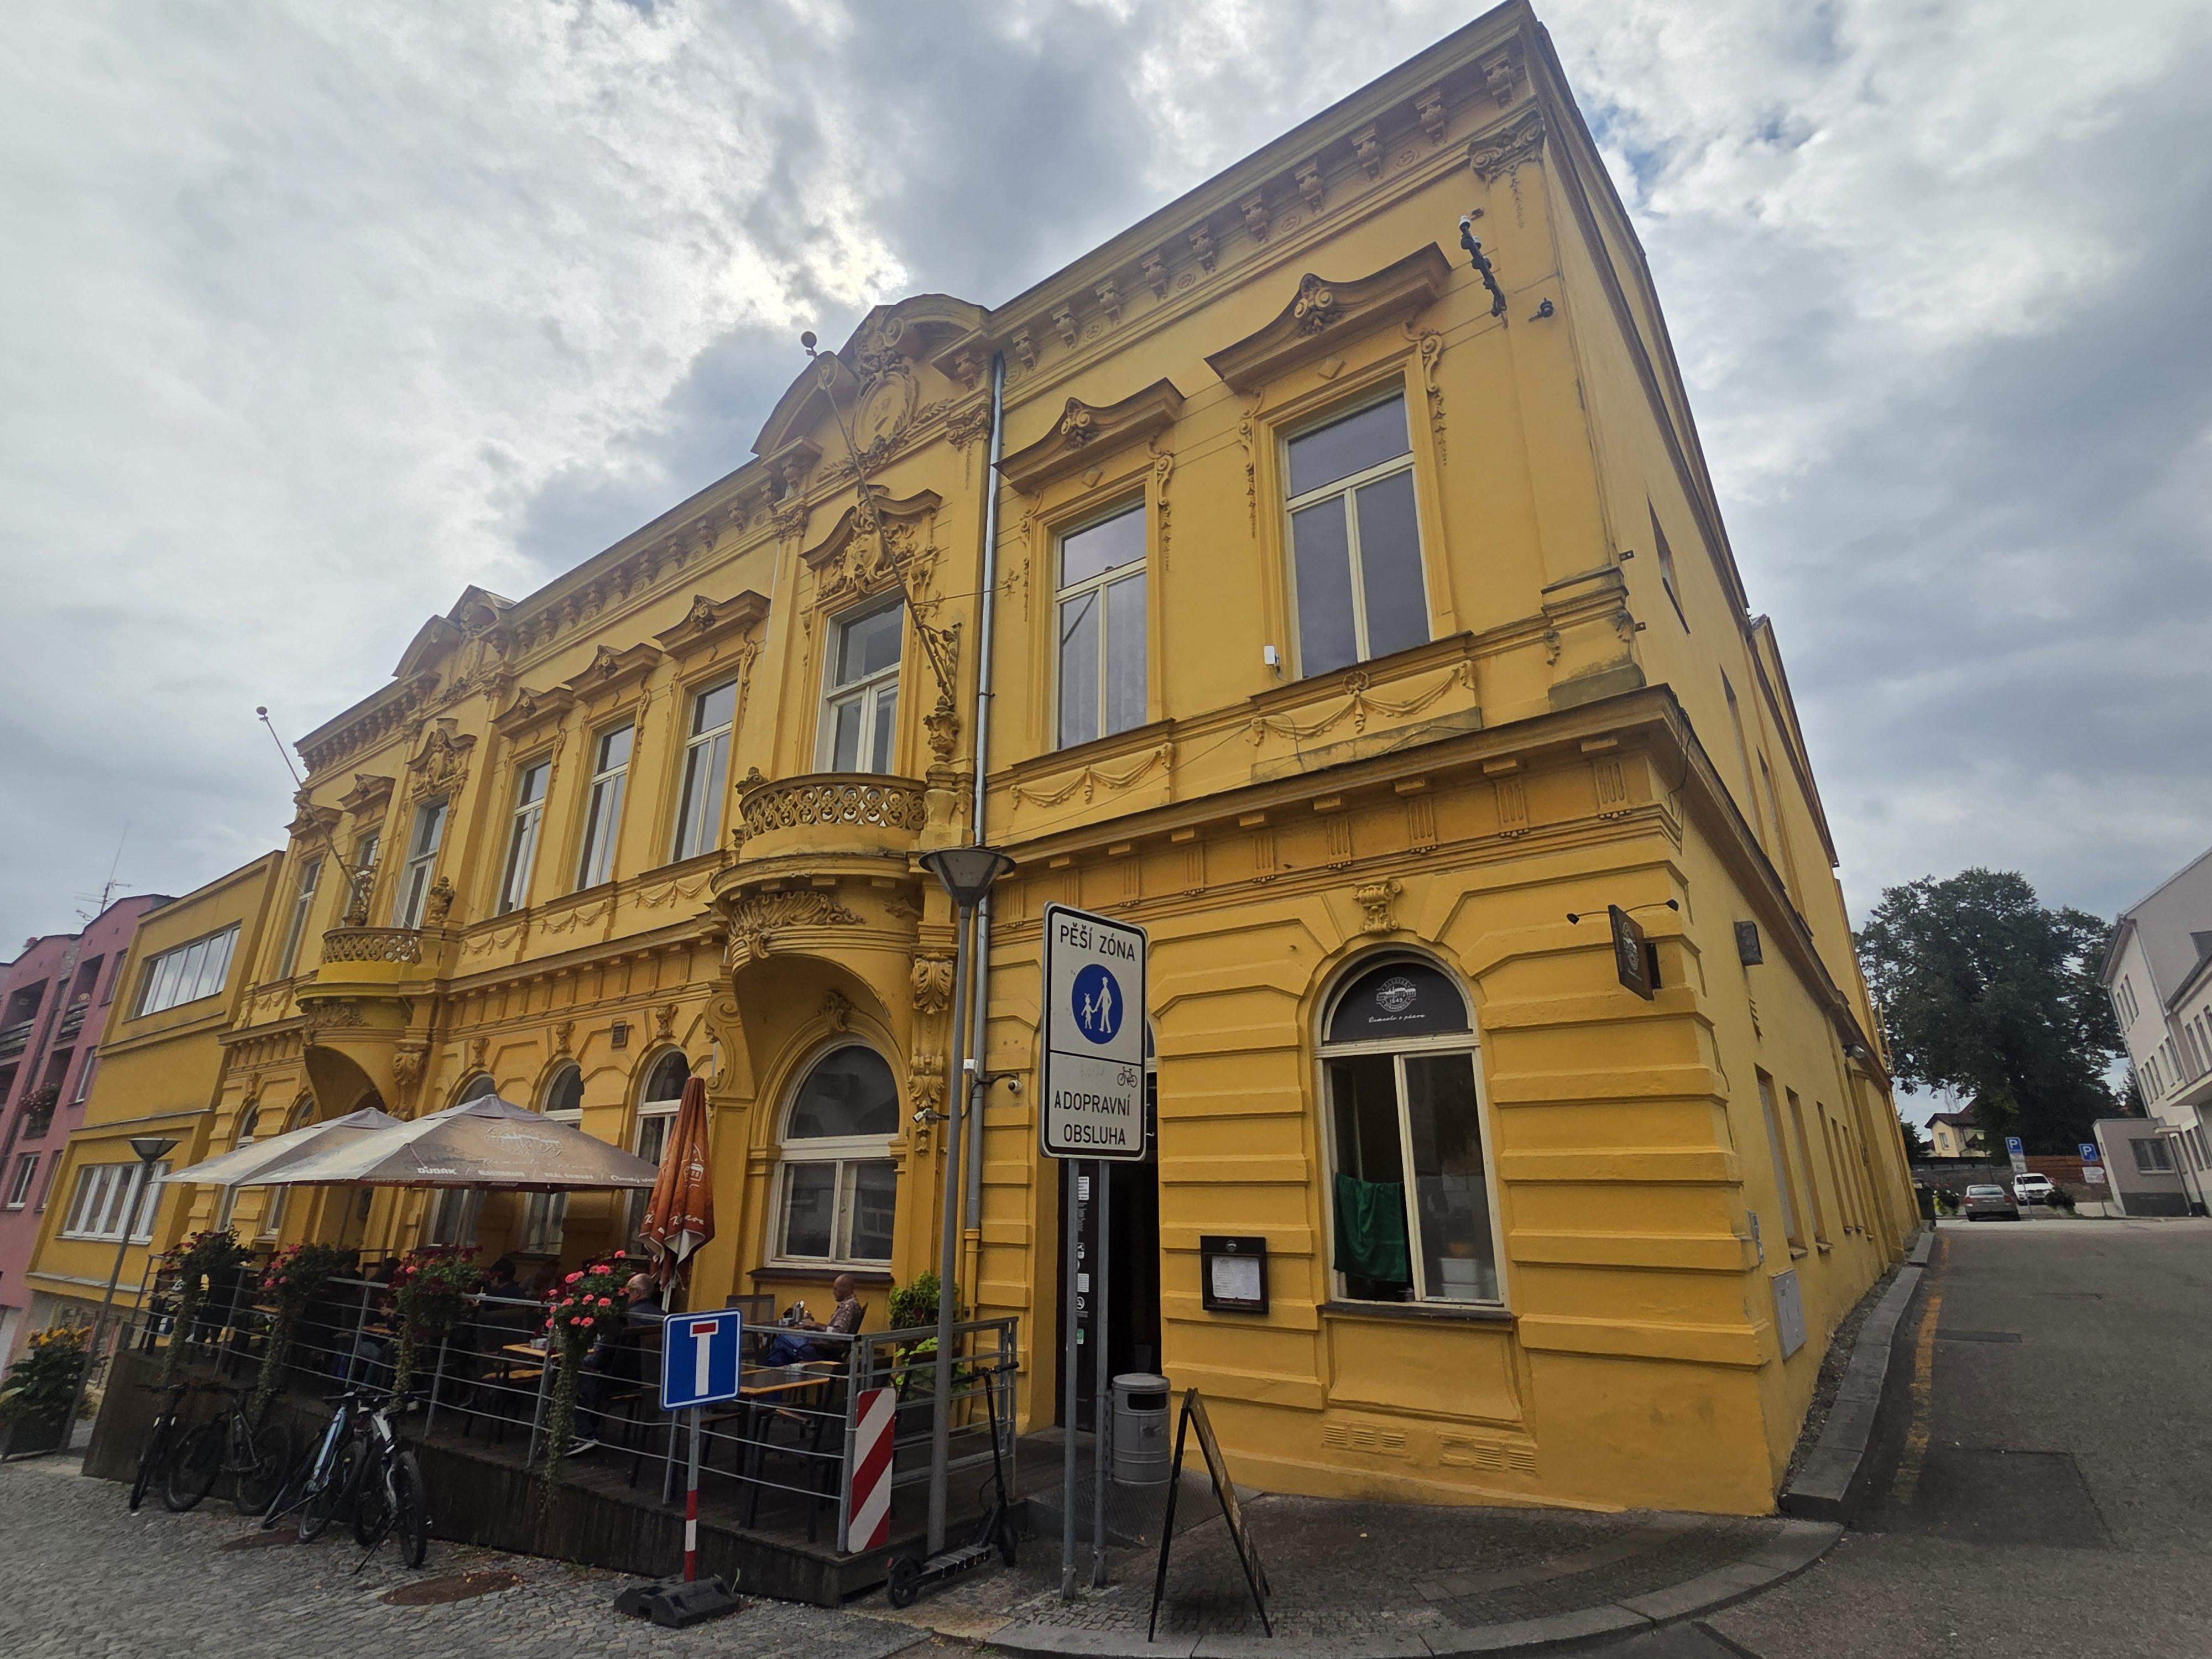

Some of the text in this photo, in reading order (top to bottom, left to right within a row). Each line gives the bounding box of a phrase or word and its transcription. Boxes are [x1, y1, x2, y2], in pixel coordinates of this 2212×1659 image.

[1060, 922, 1135, 962] PĚŠÍ ZÓNA
[1063, 1123, 1126, 1145] OBSLUHA
[2008, 1139, 2018, 1149] P
[2083, 1146, 2092, 1156] P
